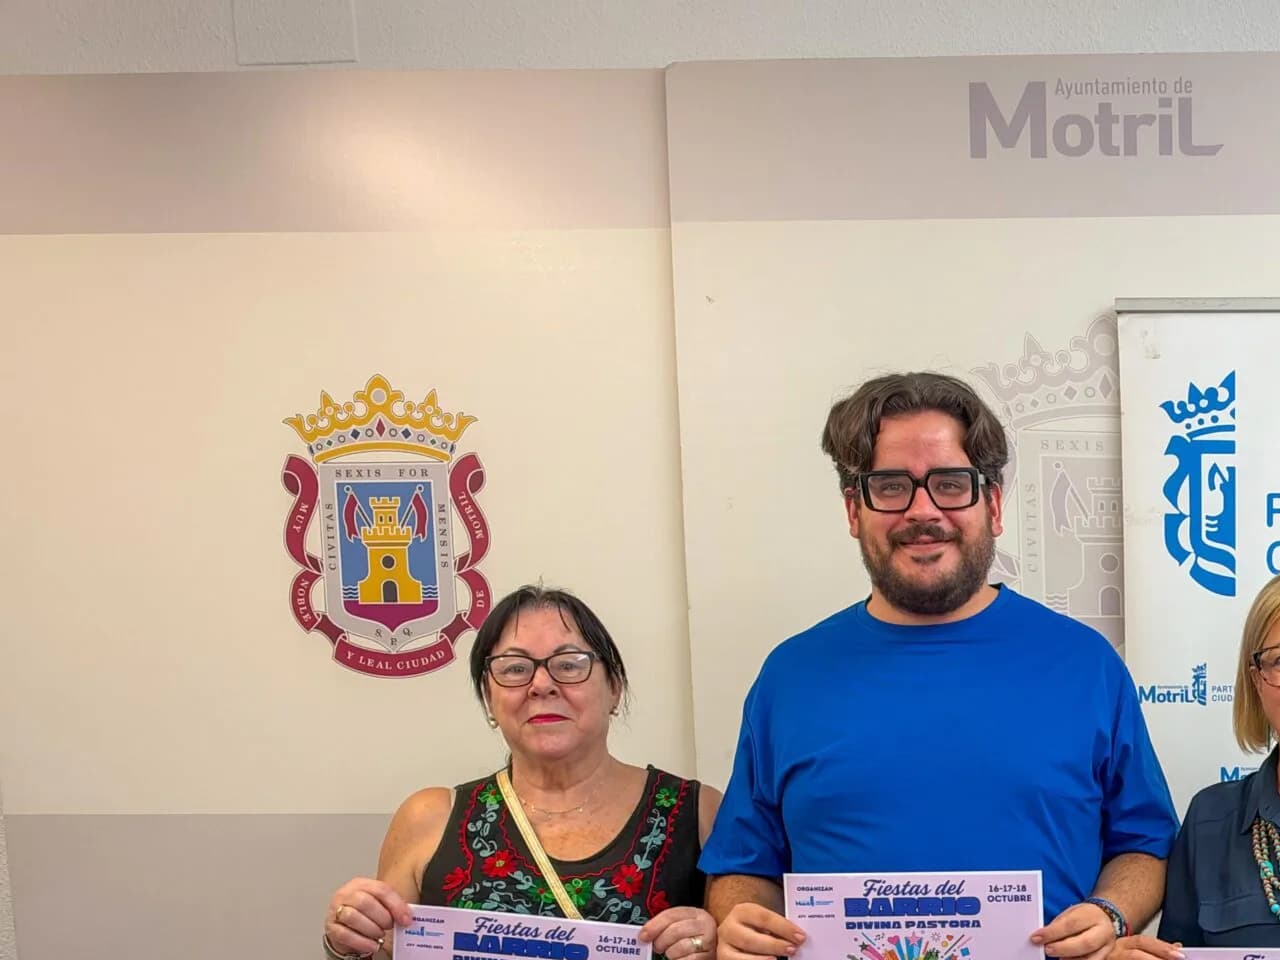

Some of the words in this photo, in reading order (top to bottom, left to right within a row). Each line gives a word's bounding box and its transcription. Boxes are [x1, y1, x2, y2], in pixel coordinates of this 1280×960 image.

[1055, 77, 1167, 99] Ayuntamiento
[1174, 77, 1192, 93] de
[1041, 440, 1103, 450] SEXIS
[335, 468, 382, 478] SEXIS
[399, 468, 429, 477] FOR
[292, 502, 309, 533] MUY
[458, 491, 483, 540] MOTRIL
[325, 503, 337, 571] CIVITAS
[438, 504, 449, 568] MENSIS
[1025, 483, 1037, 573] CIVITAS
[297, 578, 311, 624] NOBLE
[475, 590, 485, 608] DE
[359, 656, 392, 670] LEAL
[396, 650, 445, 670] CIUDAD
[863, 880, 932, 896] Fiestas
[935, 880, 965, 894] del
[844, 896, 981, 917] BARRIO
[987, 894, 1032, 903] OCTUBRE
[474, 917, 542, 940] Fiestas
[545, 925, 576, 941] del
[846, 921, 901, 930] DIVINA
[905, 920, 981, 928] PASTORA
[599, 935, 637, 945] 16-17-18
[596, 945, 641, 956] OCTUBRE
